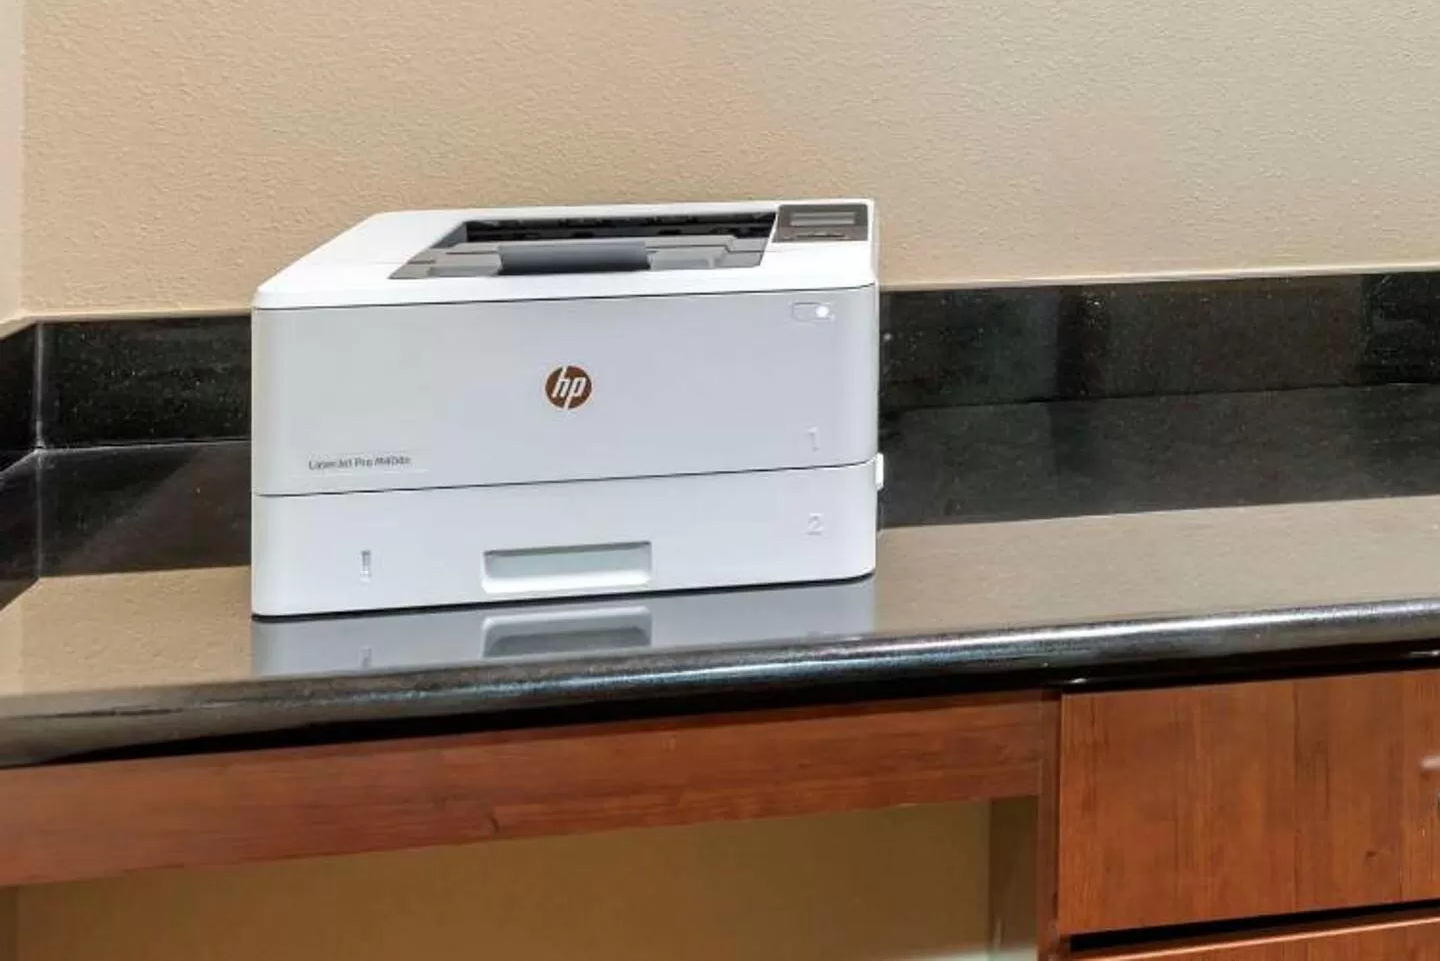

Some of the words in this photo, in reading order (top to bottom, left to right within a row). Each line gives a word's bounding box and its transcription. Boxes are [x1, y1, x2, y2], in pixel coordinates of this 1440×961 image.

[550, 366, 587, 410] hp
[354, 456, 373, 468] Pro
[806, 512, 824, 536] 2
